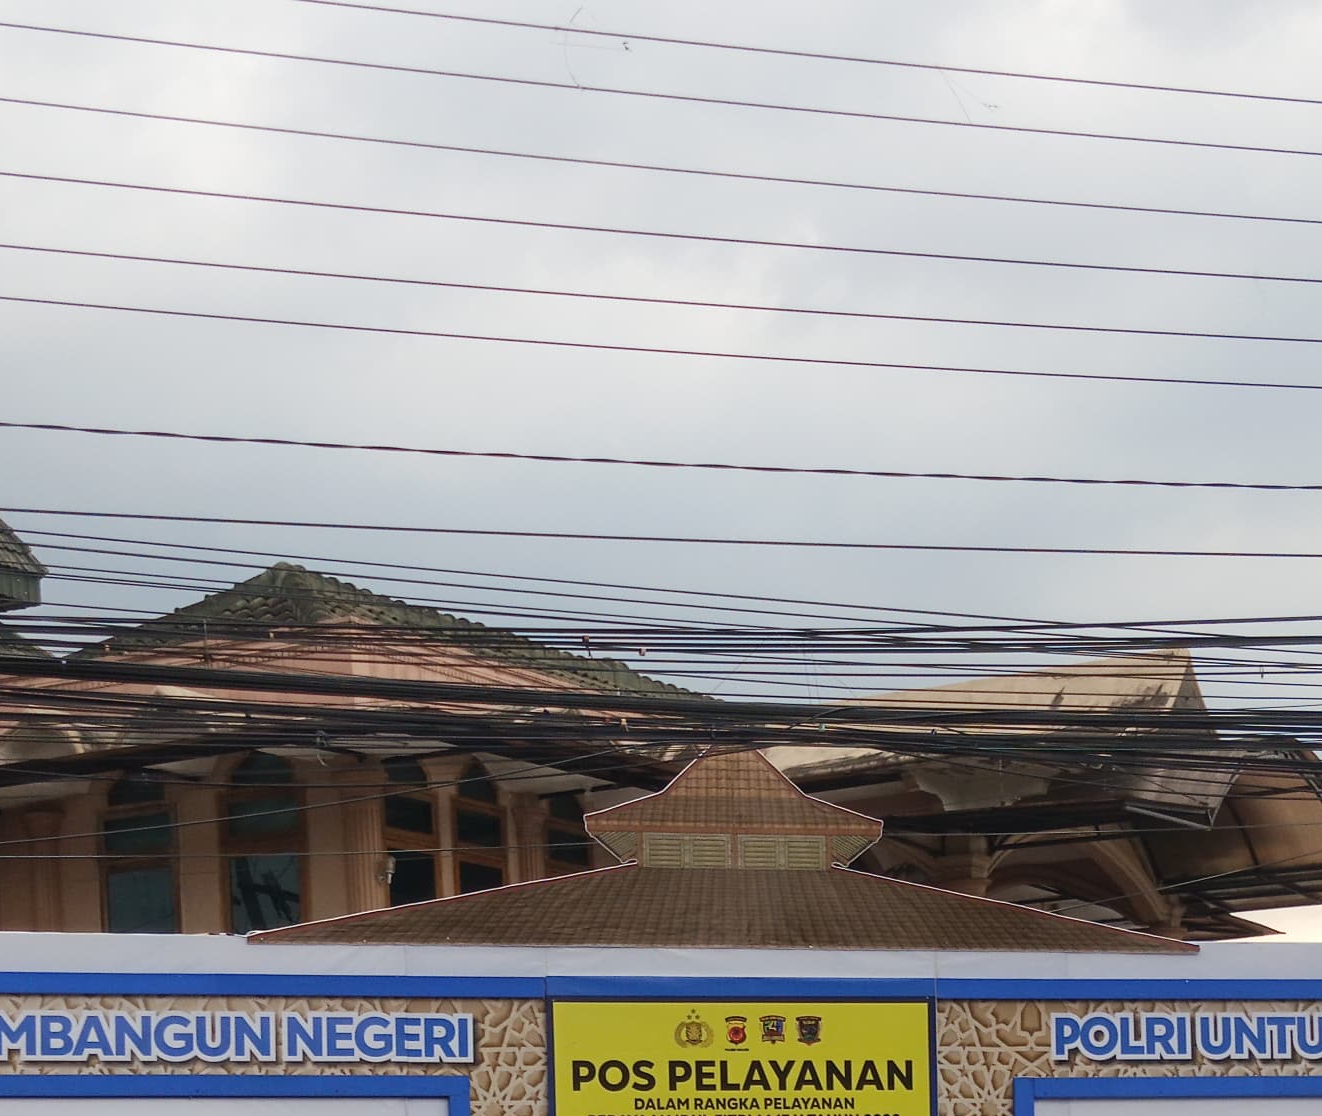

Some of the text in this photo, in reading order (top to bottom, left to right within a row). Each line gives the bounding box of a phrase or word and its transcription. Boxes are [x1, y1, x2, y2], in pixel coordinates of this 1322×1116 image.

[285, 1013, 474, 1062] NEGERI
[1052, 1012, 1191, 1060] POLRI
[572, 1059, 914, 1092] POS PELAYANAN
[634, 1098, 855, 1110] DALAM RANGKA PELAYANAN
